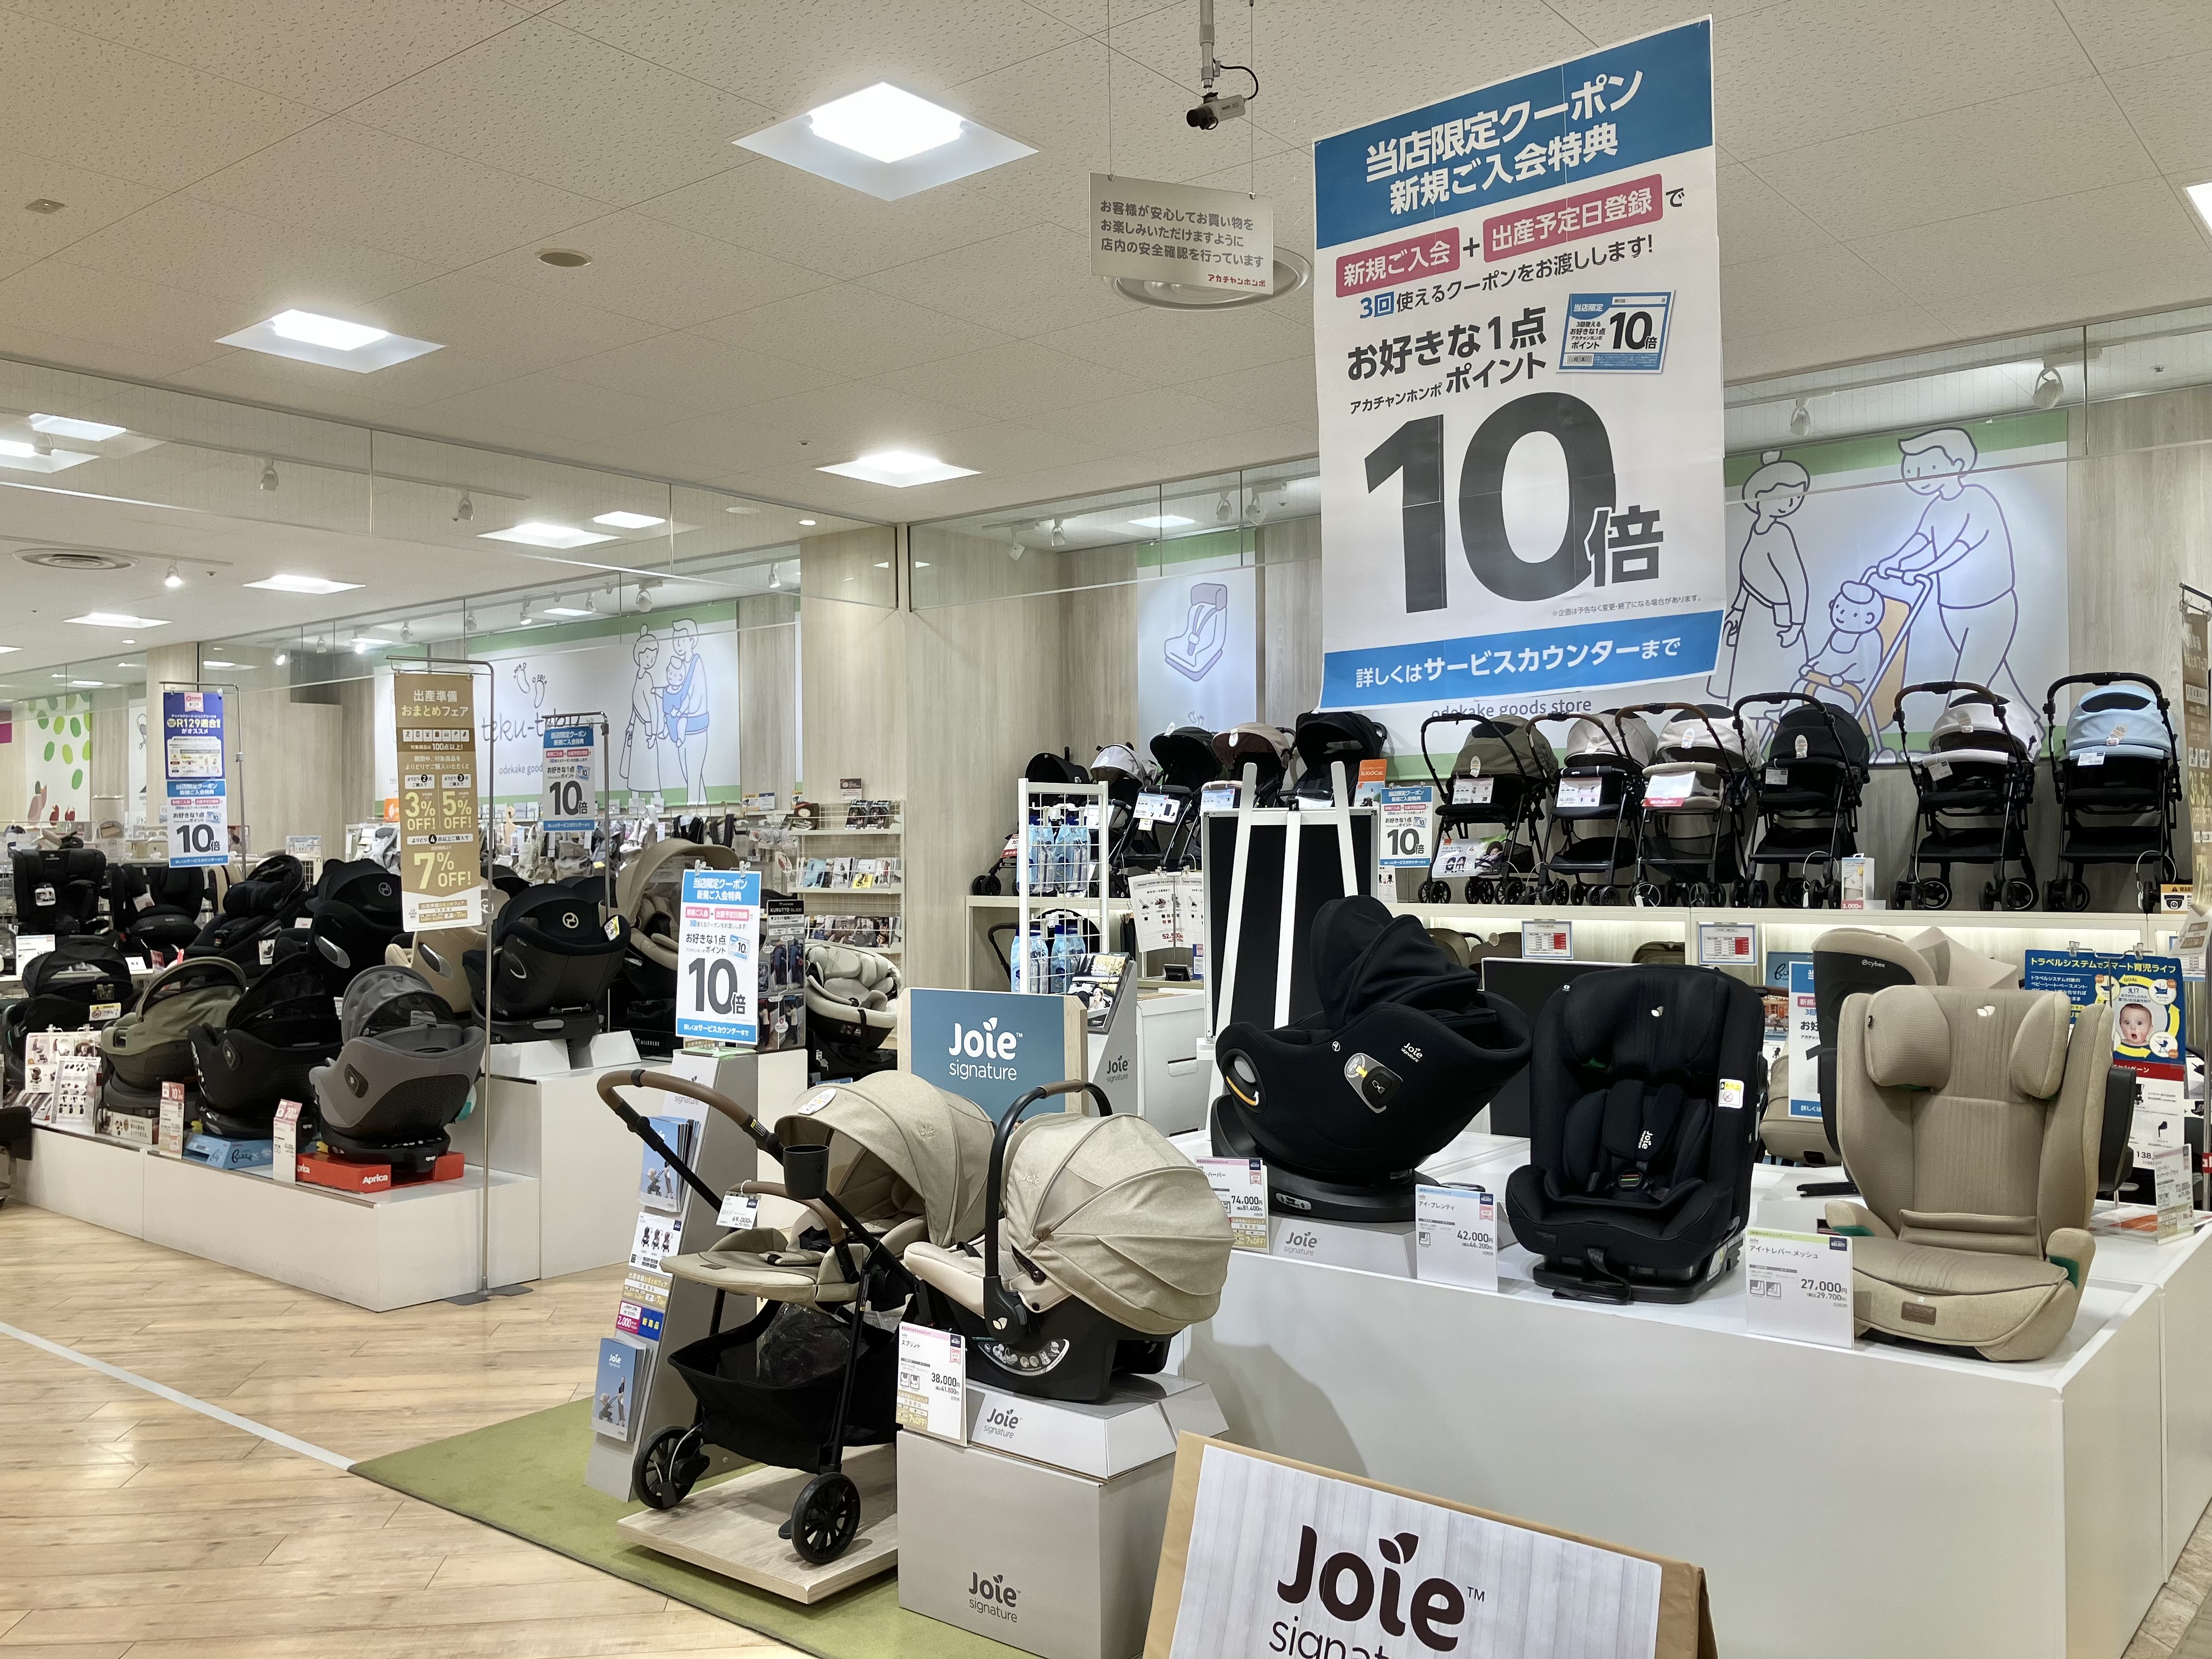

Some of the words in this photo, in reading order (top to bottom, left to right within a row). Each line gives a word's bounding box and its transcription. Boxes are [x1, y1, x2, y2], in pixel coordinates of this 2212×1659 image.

[1365, 70, 1644, 182] 当店限定クーポン
[1390, 123, 1618, 215] 新規ご入会特典
[1101, 201, 1254, 230] お客様が安心してお買い物を
[1101, 219, 1244, 247] お楽しみいただけますように
[1344, 240, 1451, 287] 新規ご入会
[1492, 188, 1652, 253] 出産予定日登録
[1101, 238, 1264, 268] 店内の安全確認を行っています
[1208, 274, 1266, 287] アカチャンホンポ
[1360, 234, 1654, 319] 3回使えるクーポンをお渡しします!
[1573, 303, 1604, 312] 当店限定
[1347, 306, 1547, 381] お好きな1点
[1571, 341, 1600, 350] ポイント
[1350, 382, 1442, 414] アカチャンホンポ
[1446, 352, 1547, 394] ポイント
[1356, 636, 1681, 689] 詳しくはサービスカウンターまで
[414, 690, 458, 702] 出産準備
[402, 705, 469, 717] おまとめフェア
[1499, 699, 1546, 715] goods
[1551, 699, 1592, 714] store
[499, 766, 526, 774] odekake
[527, 764, 543, 775] good
[407, 818, 436, 831] OFF!
[444, 816, 471, 829] OFF!
[438, 871, 471, 888] OFF!
[693, 878, 748, 890] 当店限定クーポン
[697, 890, 742, 901] 新規ご入会特典
[687, 909, 708, 917] 新規ご入会
[686, 934, 726, 946] お好きな1点
[2031, 958, 2176, 973] トラベルシステムでスマート育児ライフ
[684, 1024, 749, 1036] 詳しくはサービスカウンターまで
[949, 1017, 1017, 1060] Joie
[1403, 1043, 1423, 1059] Joie
[949, 1059, 1017, 1081] signature
[1107, 1055, 1128, 1074] Joie
[1107, 1073, 1128, 1084] signature
[675, 1095, 699, 1105] signature
[1642, 1131, 1653, 1149] Joie
[297, 1164, 310, 1174] prica
[362, 1173, 388, 1185] Aprica
[1022, 1173, 1039, 1186] Joie
[1231, 1195, 1262, 1205] 74,000円
[1286, 1232, 1317, 1248] Joie
[1457, 1230, 1493, 1243] 42,000円
[1284, 1245, 1314, 1256] signature
[1749, 1245, 1791, 1254] アイ・トレバー
[1793, 1250, 1818, 1259] メッシュ
[1801, 1278, 1847, 1294] 27,000円
[901, 1340, 921, 1348] スプリント
[609, 1353, 621, 1364] Joie
[931, 1373, 960, 1388] 38,000円
[986, 1408, 1019, 1429] Joie
[983, 1425, 1014, 1438] signature
[969, 1572, 1017, 1607] Joie
[1277, 1525, 1465, 1652] Joie
[969, 1597, 1017, 1623] signature
